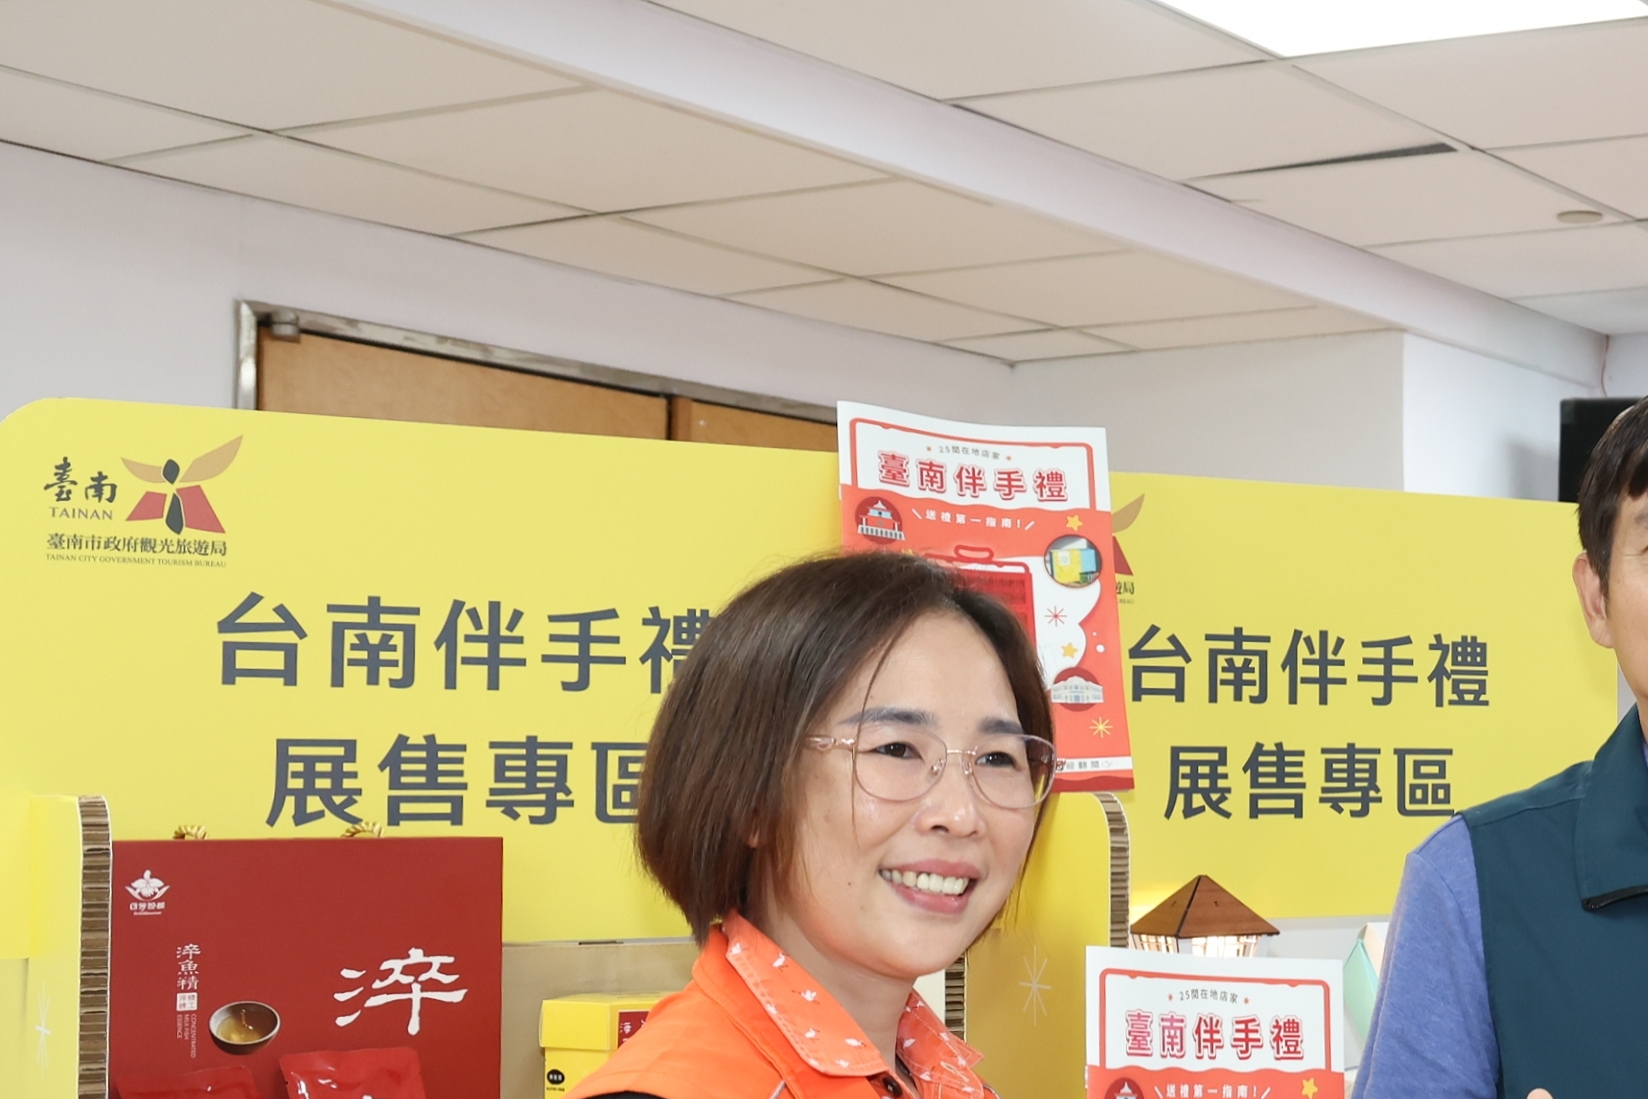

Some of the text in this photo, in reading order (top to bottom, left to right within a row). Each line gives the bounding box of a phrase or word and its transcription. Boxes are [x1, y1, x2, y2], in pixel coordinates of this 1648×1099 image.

[44, 457, 117, 503] 臺南
[878, 451, 1068, 502] 臺南伴手禮
[49, 507, 113, 520] TAINAN
[46, 554, 226, 568] TAINAN CITY GOVERNMENT TOURISM BUREAU
[47, 533, 227, 556] 臺南市政府觀光旅遊局
[1127, 623, 1490, 708] 台南伴手禮
[1163, 741, 1456, 821] 展售專區
[334, 947, 468, 1036] 淬
[1125, 1009, 1304, 1060] 臺南伴手禮
